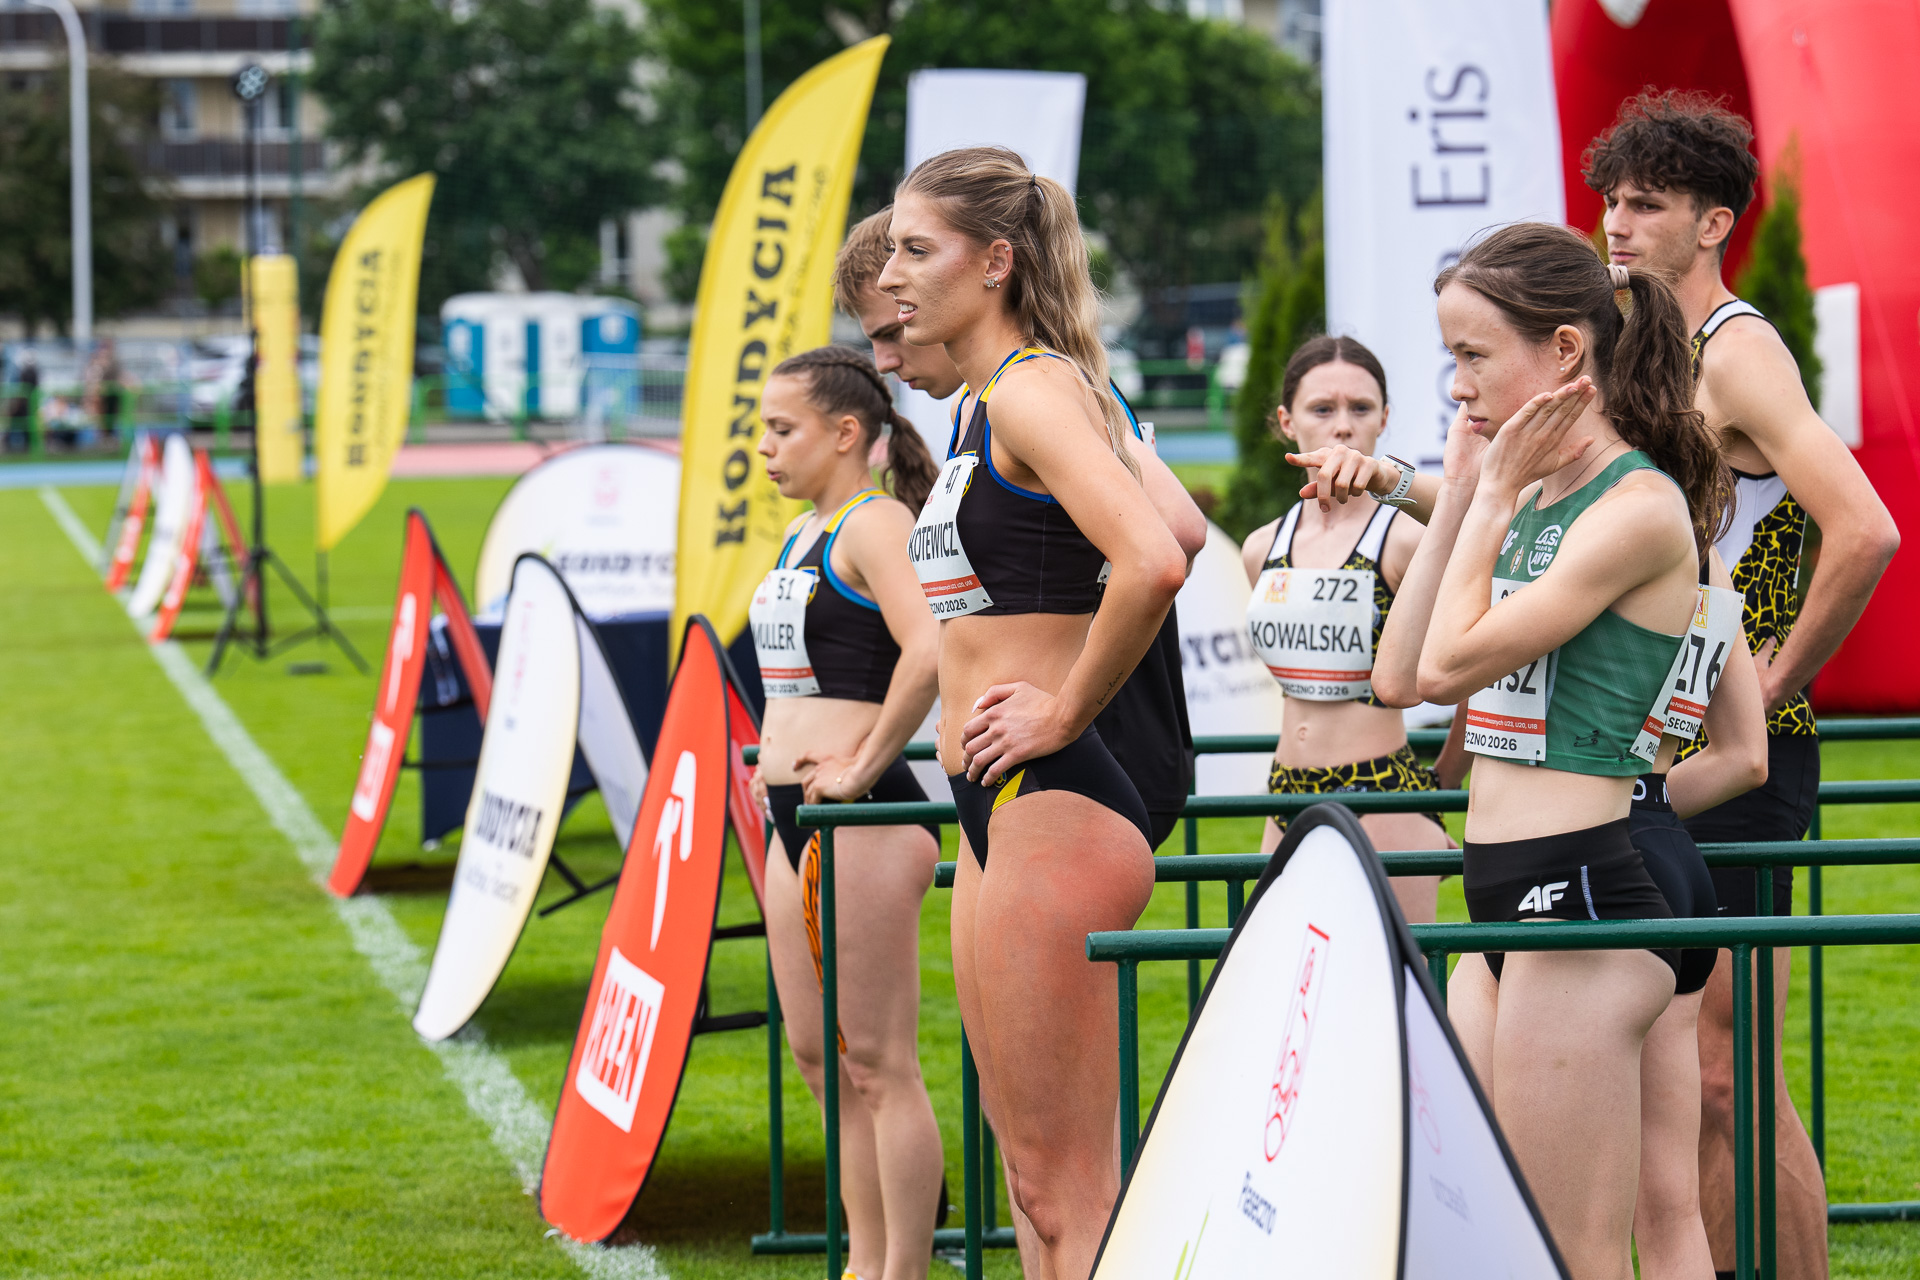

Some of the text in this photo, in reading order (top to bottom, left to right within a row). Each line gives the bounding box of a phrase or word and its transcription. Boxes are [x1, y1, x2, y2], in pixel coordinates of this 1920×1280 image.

[1408, 65, 1490, 208] Eris
[714, 161, 800, 549] KONDYCJA
[777, 577, 795, 600] 51
[1312, 577, 1358, 602] 272
[945, 598, 968, 612] 2026
[1250, 621, 1364, 653] KOWALSKA
[1318, 686, 1349, 696] 2026
[1487, 735, 1517, 751] 2026
[1518, 881, 1569, 913] 4F
